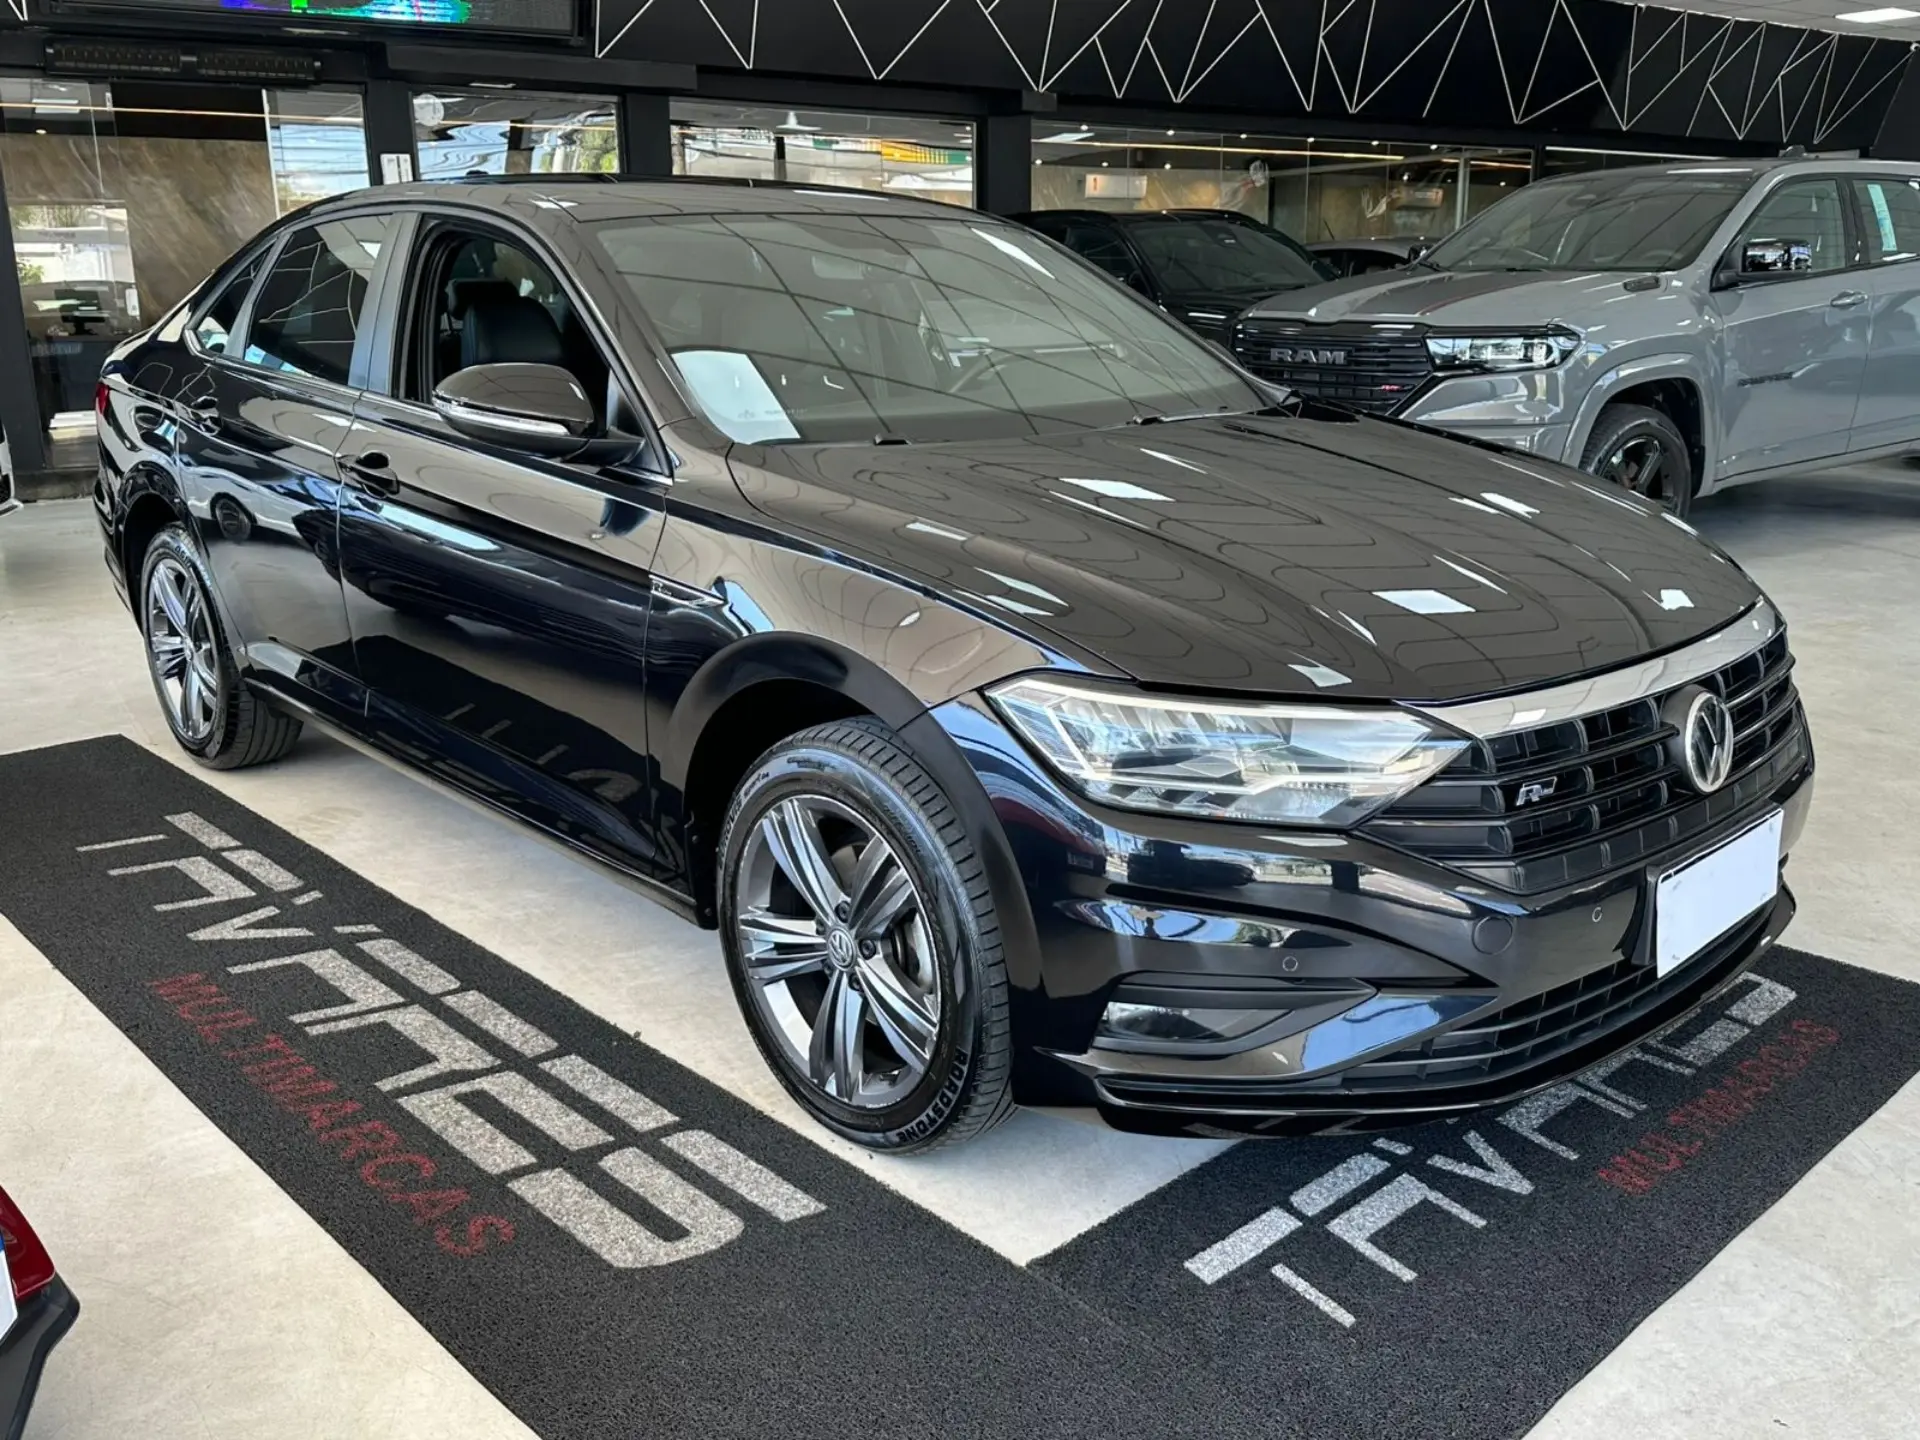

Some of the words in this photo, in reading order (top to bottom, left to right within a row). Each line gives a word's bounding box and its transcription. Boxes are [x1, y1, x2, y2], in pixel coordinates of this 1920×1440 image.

[1270, 347, 1348, 365] RAM
[148, 972, 516, 1257] MULTIMARCAS
[895, 1046, 969, 1143] ROADSTONE
